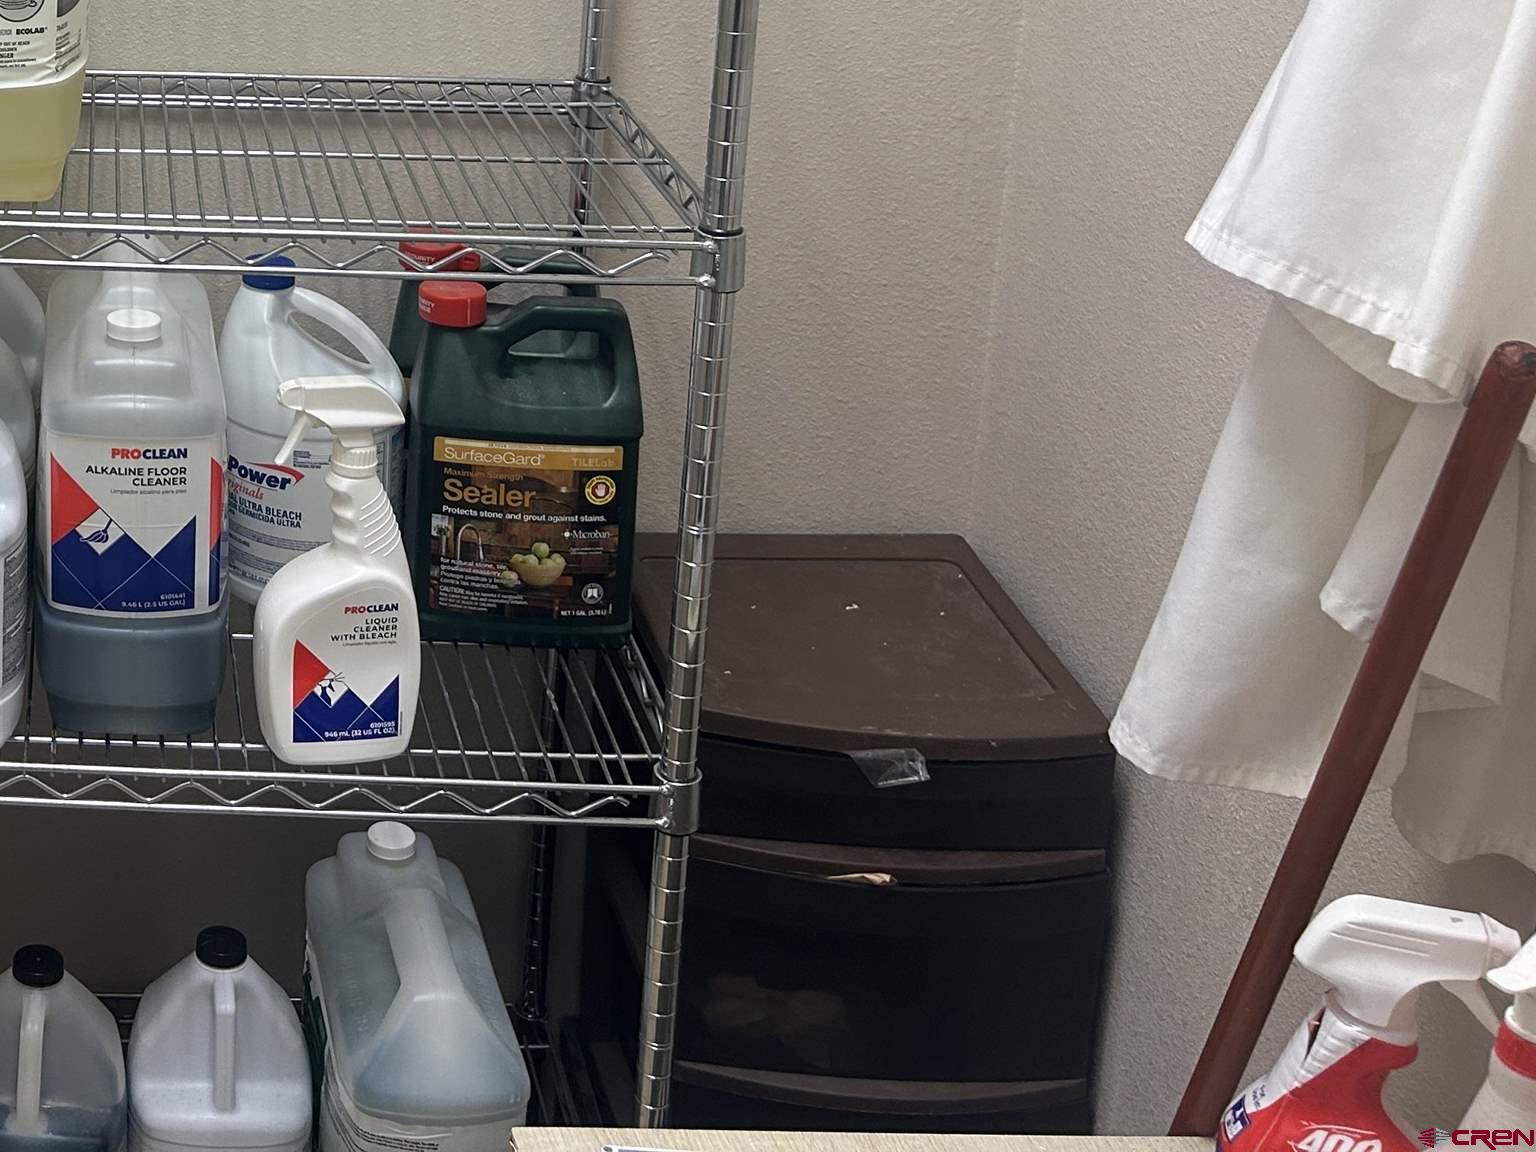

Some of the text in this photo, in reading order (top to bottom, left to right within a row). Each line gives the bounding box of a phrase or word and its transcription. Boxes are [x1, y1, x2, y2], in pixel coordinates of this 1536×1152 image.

[112, 448, 188, 460] PROCLEAN
[444, 447, 542, 466] SurfaceGard
[85, 465, 187, 476] ALKALINE FLOOR
[228, 455, 292, 490] Power
[444, 467, 524, 481] Maximum Strength
[132, 476, 187, 486] CLEANER
[442, 478, 536, 508] Sealer
[238, 497, 302, 521] ULTRA BLEACH
[442, 504, 606, 524] Protects stone and grout against stains.
[276, 519, 302, 528] ULTRA
[158, 600, 168, 608] US
[344, 602, 399, 614] PROCLEAN
[365, 616, 398, 625] LIQUID
[353, 624, 398, 634] CLEANER
[331, 632, 397, 642] WITH BLEACH
[324, 730, 338, 738] 946
[339, 730, 350, 738] mL
[351, 729, 362, 738] (32
[374, 728, 382, 736] FL
[382, 727, 396, 735] OZ)
